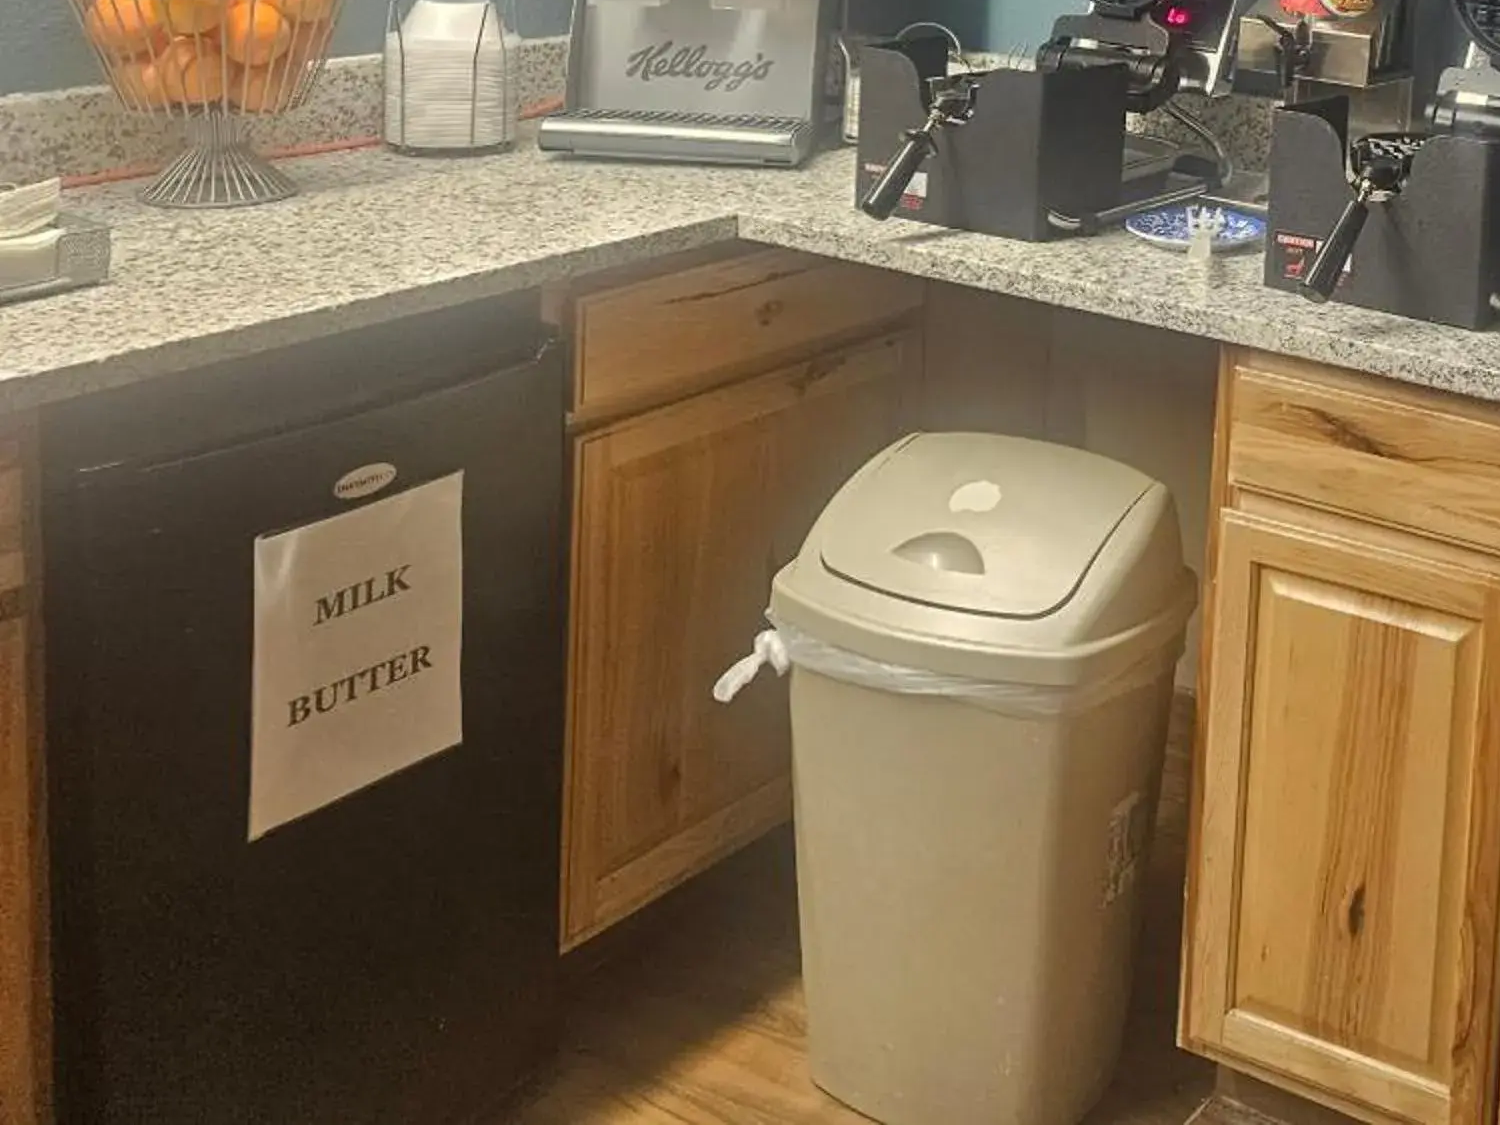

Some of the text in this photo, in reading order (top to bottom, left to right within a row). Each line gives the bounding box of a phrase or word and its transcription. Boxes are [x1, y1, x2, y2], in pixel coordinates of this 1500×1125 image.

[625, 40, 775, 92] Kellogg's
[312, 564, 413, 627] MILK
[286, 644, 434, 728] BUTTER
